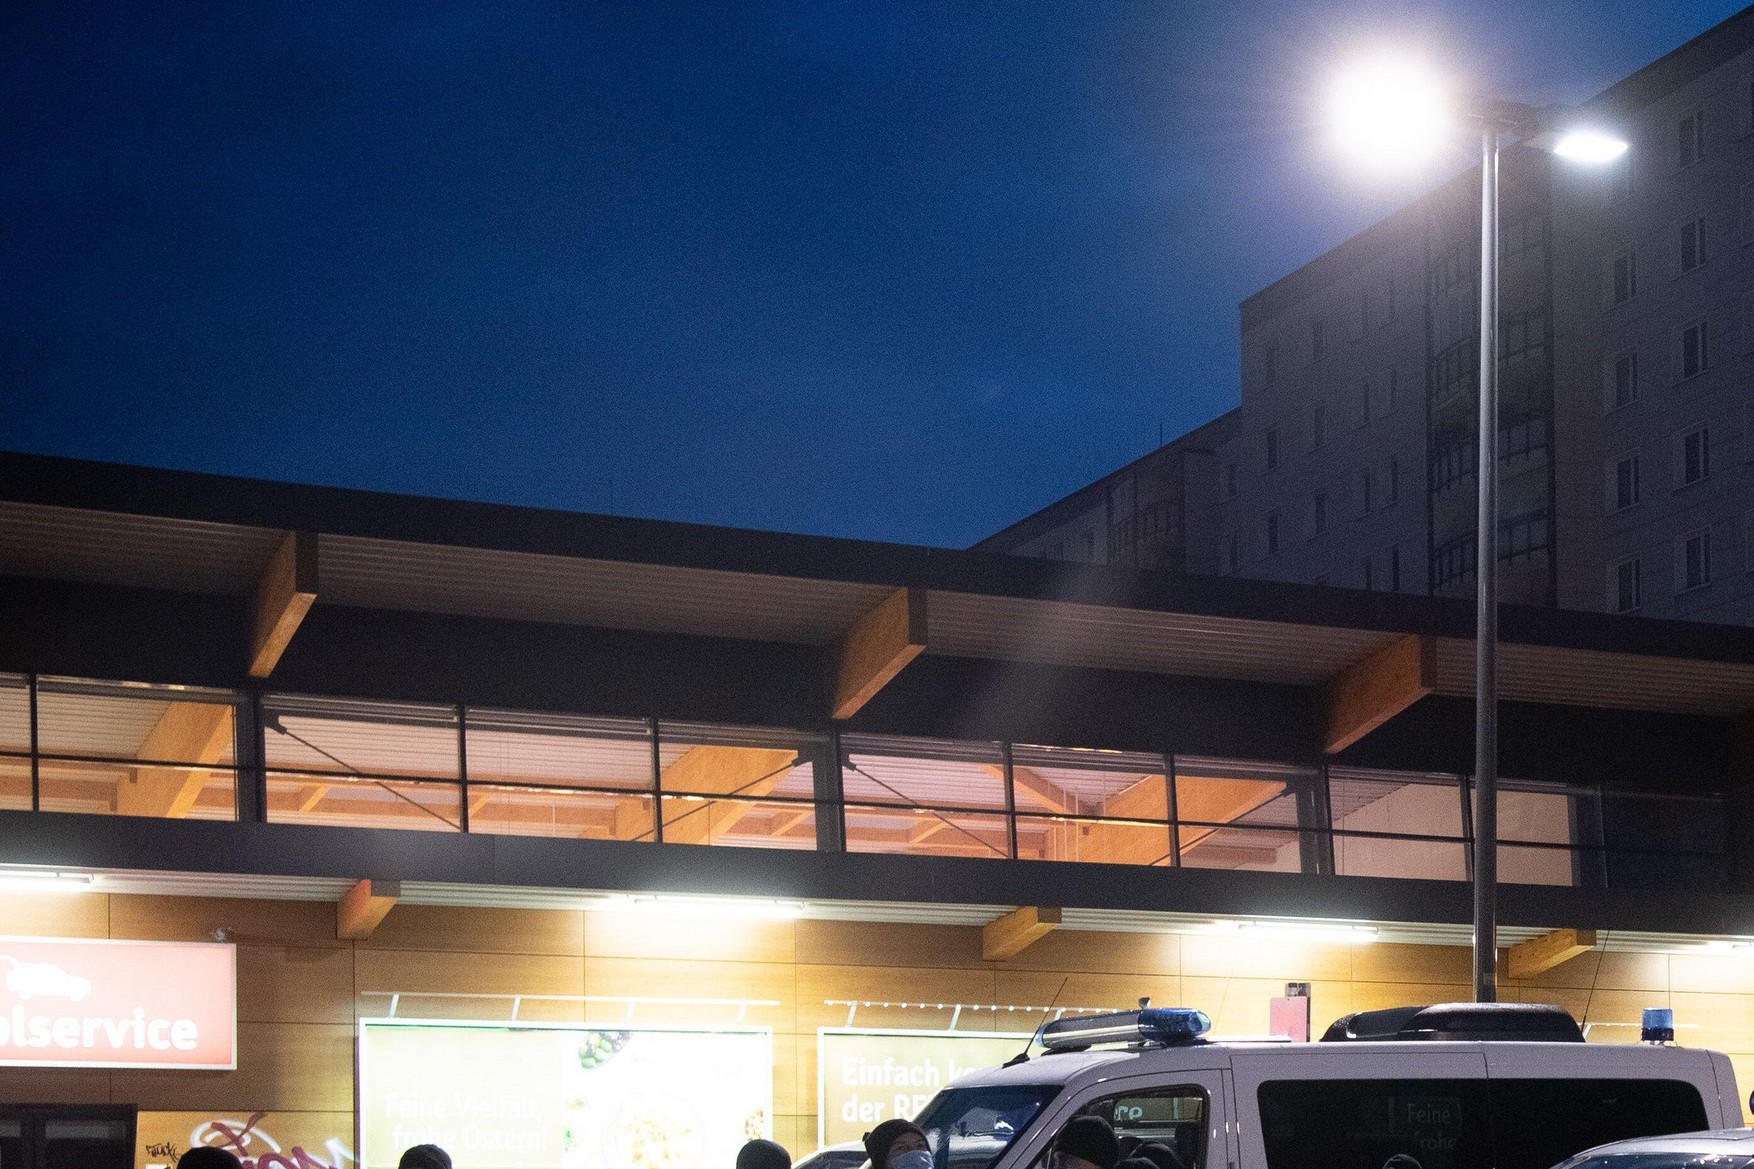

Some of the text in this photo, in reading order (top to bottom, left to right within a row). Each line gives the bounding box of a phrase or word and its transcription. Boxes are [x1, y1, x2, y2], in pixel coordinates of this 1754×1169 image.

[842, 1056, 940, 1087] Einfach
[384, 1092, 449, 1120] Feine
[841, 1093, 886, 1123] der
